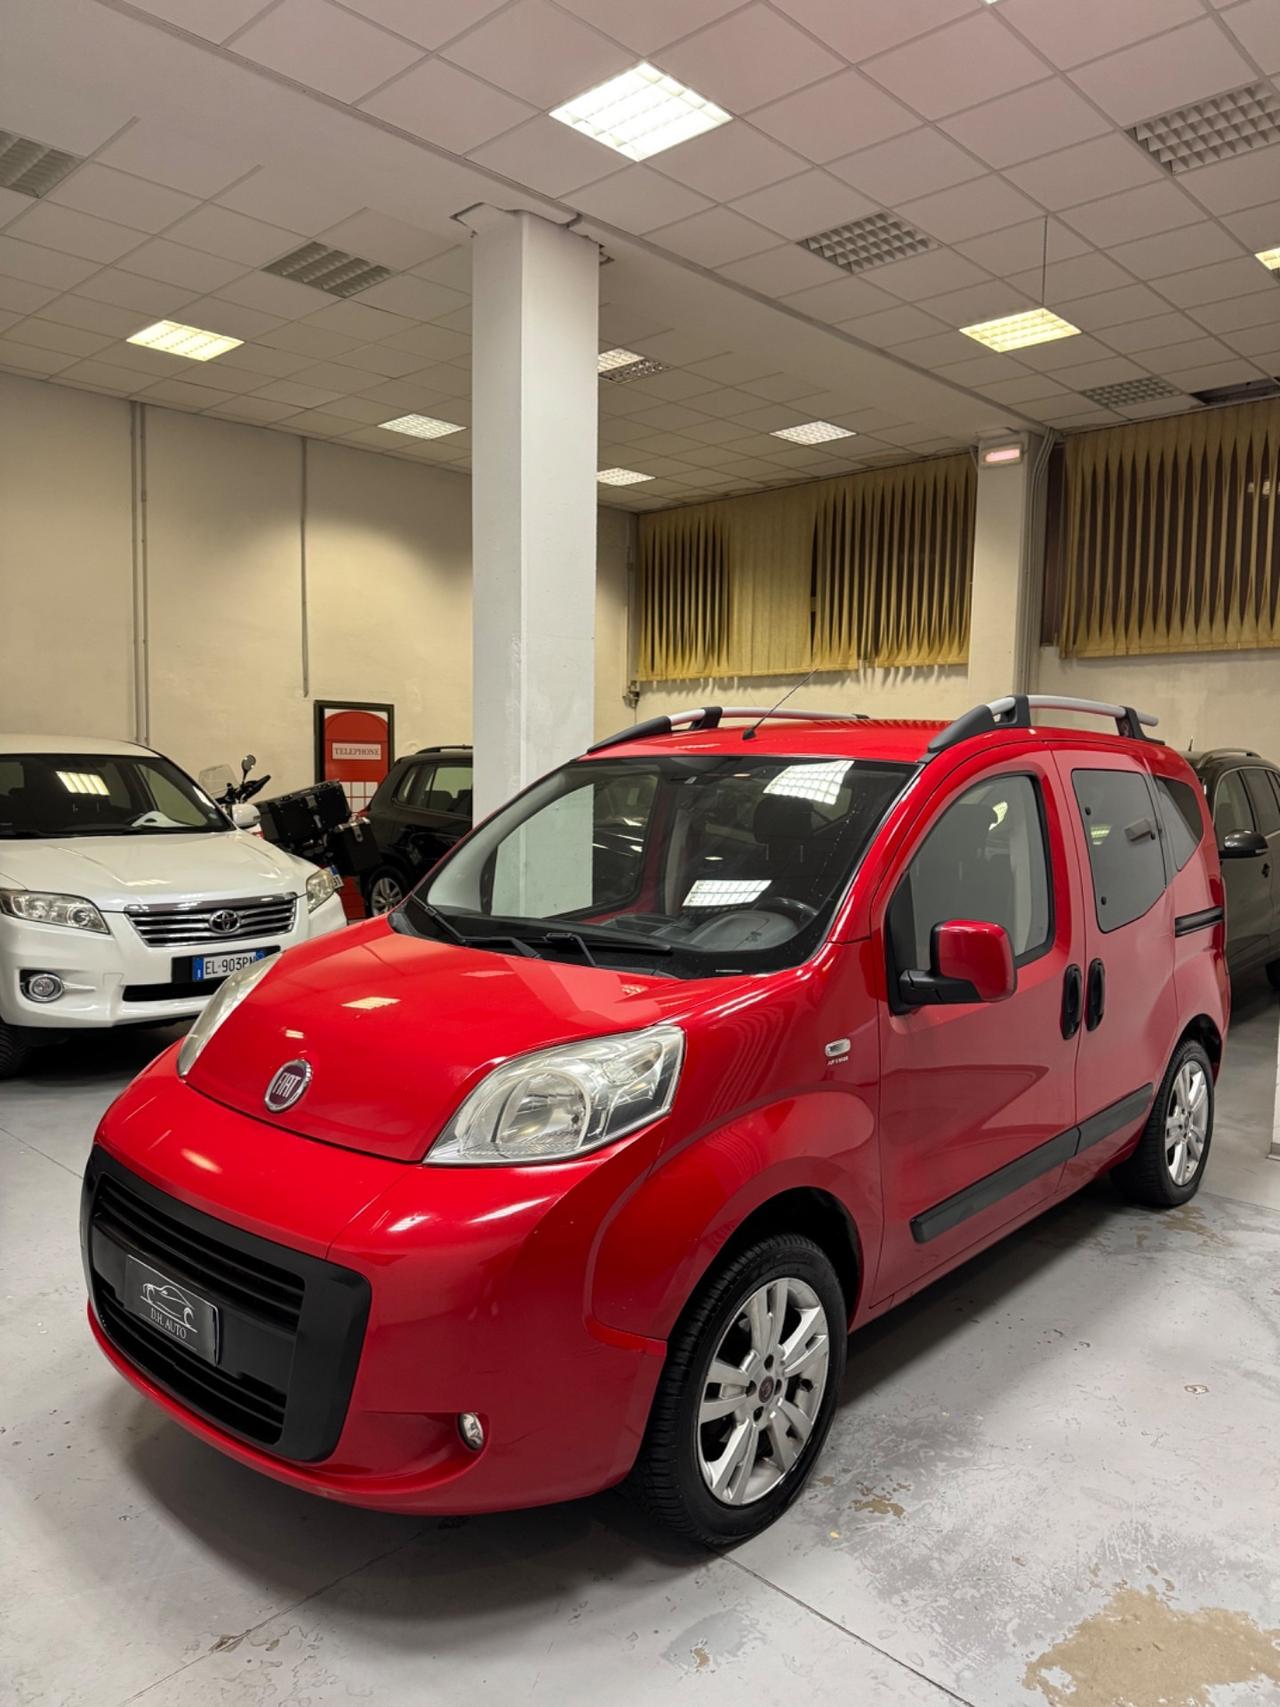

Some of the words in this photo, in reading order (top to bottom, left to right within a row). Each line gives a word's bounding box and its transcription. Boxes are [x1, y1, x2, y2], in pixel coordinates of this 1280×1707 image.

[334, 747, 380, 756] TELEPHONE
[272, 1072, 302, 1098] FIAT
[165, 1318, 187, 1339] AUTO
